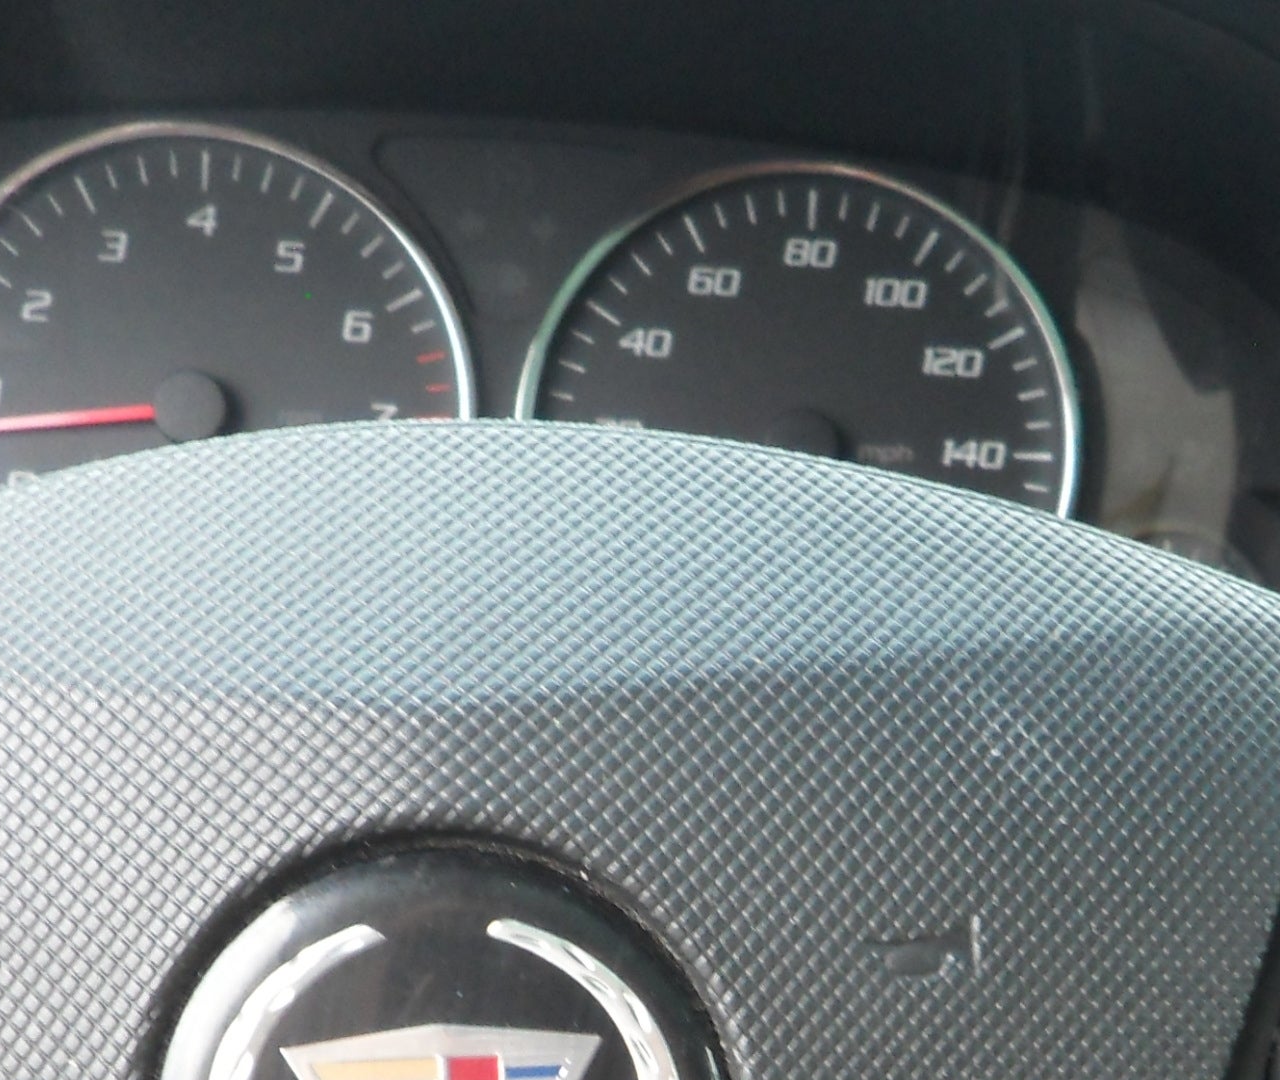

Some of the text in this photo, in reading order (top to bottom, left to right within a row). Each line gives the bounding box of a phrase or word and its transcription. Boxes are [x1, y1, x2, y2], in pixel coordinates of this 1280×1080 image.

[185, 203, 218, 237] 4
[97, 229, 129, 263] 3
[273, 240, 306, 273] 5
[783, 238, 837, 269] 80
[687, 267, 741, 299] 60
[864, 275, 927, 309] 100
[20, 288, 53, 323] 2
[341, 309, 374, 344] 6
[618, 326, 673, 360] 40
[922, 345, 984, 378] 120
[941, 437, 1007, 470] 140
